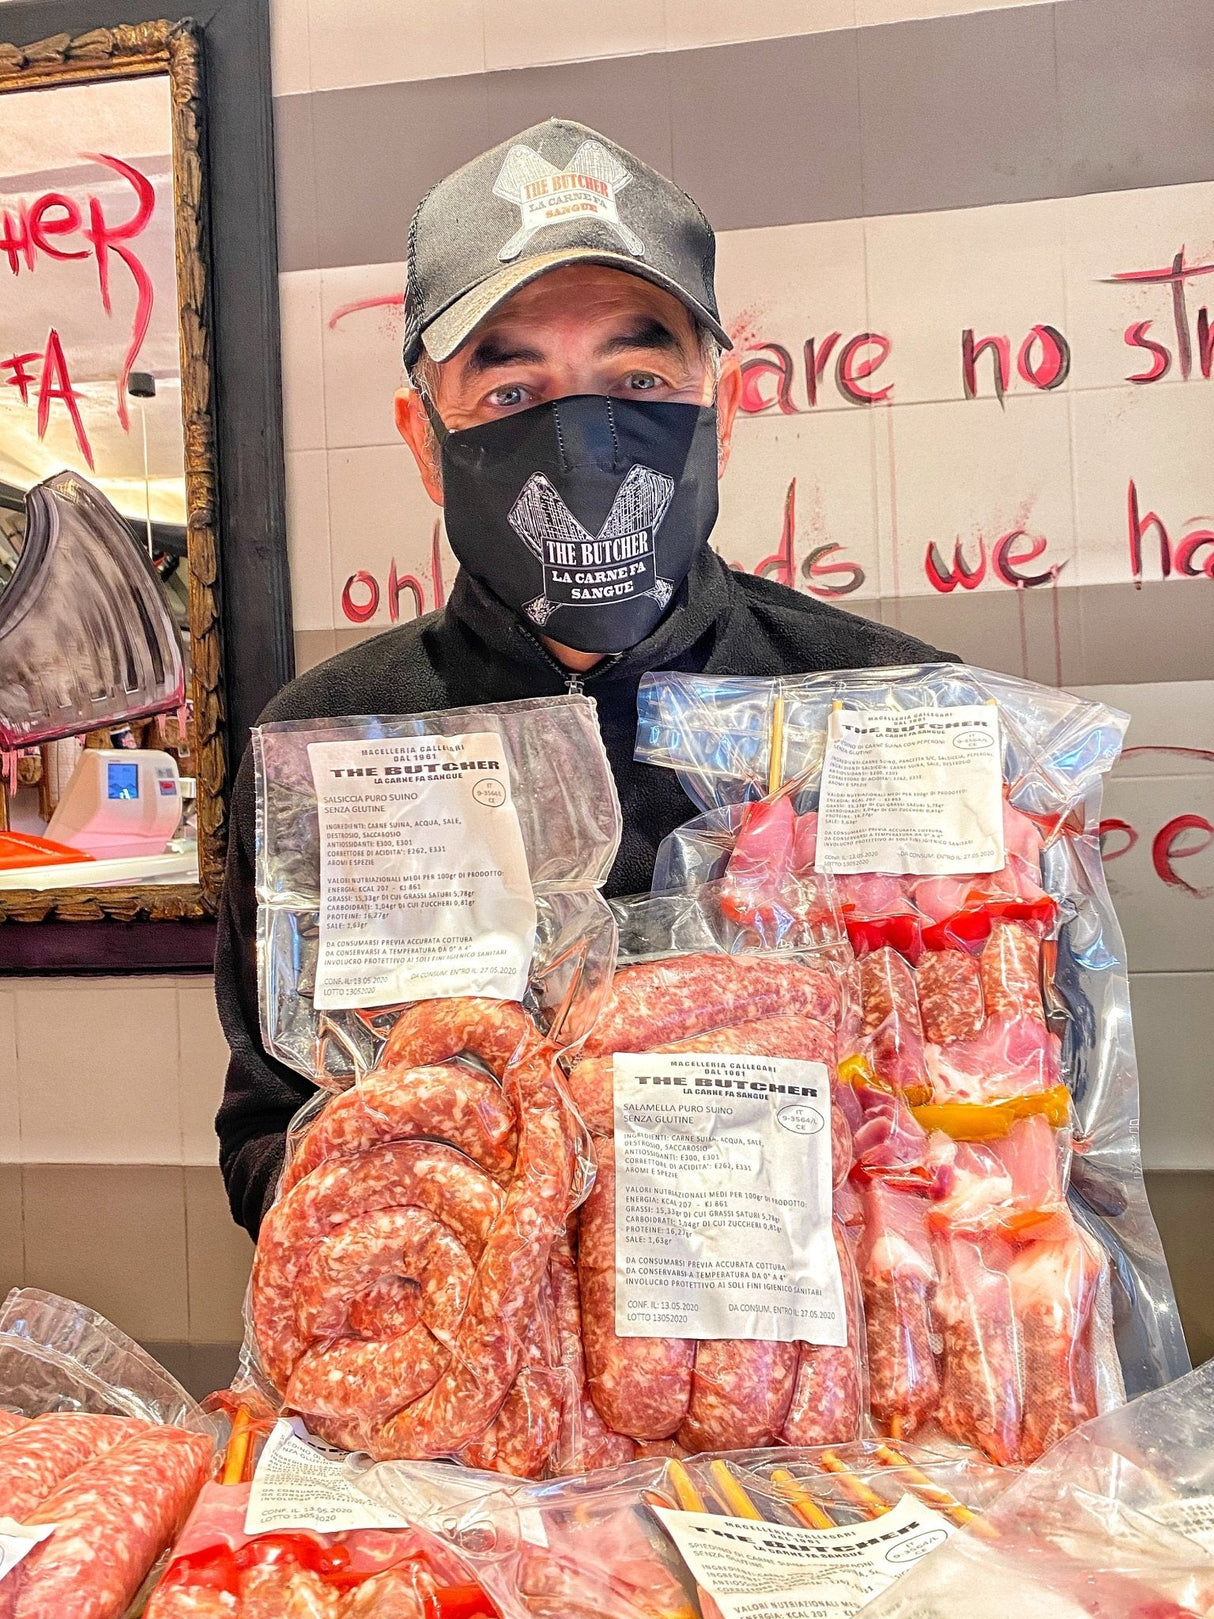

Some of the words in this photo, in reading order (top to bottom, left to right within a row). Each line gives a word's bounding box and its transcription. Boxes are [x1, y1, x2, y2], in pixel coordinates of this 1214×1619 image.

[524, 180, 549, 200] THE
[552, 173, 609, 198] BUTCHER
[529, 200, 546, 213] LA
[548, 192, 592, 207] CARNE
[592, 196, 608, 210] FA
[545, 202, 598, 218] SANGUE
[740, 330, 895, 415] are
[962, 323, 1070, 411] no
[546, 540, 577, 566] THE
[581, 531, 648, 566] BUTCHER
[341, 517, 446, 624] onl
[924, 528, 1070, 593] we
[552, 570, 572, 584] LA
[575, 566, 628, 584] CARNE
[630, 562, 646, 576] FA
[571, 581, 634, 599] SANGUE
[886, 721, 988, 732] BUTCHER
[361, 747, 416, 756] MACELLERIA
[330, 767, 378, 778] THE
[384, 760, 500, 776] BUTCHER
[384, 776, 414, 784] CARNE
[428, 772, 464, 782] SANGUE
[324, 795, 364, 804] SALSICCIA
[364, 794, 388, 802] PURO
[389, 792, 418, 801] SUINO
[324, 806, 352, 814] SENZA
[352, 805, 386, 813] GLUTINE
[670, 1060, 726, 1068] MACELLERIA
[634, 1076, 688, 1086] THE
[695, 1078, 818, 1097] BUTCHER
[736, 1092, 769, 1100] SANGUE
[624, 1103, 676, 1112] SALAMELLA
[678, 1104, 704, 1113] PURO
[706, 1105, 734, 1115] SUINO
[624, 1114, 652, 1123] SENZA
[654, 1116, 694, 1124] GLUTINE
[671, 1134, 696, 1142] CARNE
[665, 1144, 708, 1152] SACCAROSIO
[680, 1154, 700, 1162] E300,
[626, 1196, 660, 1204] ENERGIA:
[626, 1205, 654, 1214] GRASSI:
[736, 1210, 760, 1219] SATURI
[728, 1220, 762, 1228] ZUCCHERI
[626, 1226, 664, 1234] PROTEINE:
[638, 1257, 686, 1267] CONSUMARSI
[688, 1260, 713, 1268] PREVIA
[716, 1260, 754, 1268] ACCURATA
[756, 1262, 786, 1270] COTTURA
[638, 1268, 687, 1278] CONSERVARSI
[696, 1271, 750, 1279] TEMPERATURA
[626, 1278, 669, 1286] INVOLUCRO
[671, 1280, 716, 1288] PROTETTIVO
[628, 1300, 650, 1308] CONF.
[627, 1313, 652, 1321] LOTTO
[688, 1525, 756, 1544] THE
[762, 1520, 920, 1552] BUTCHER
